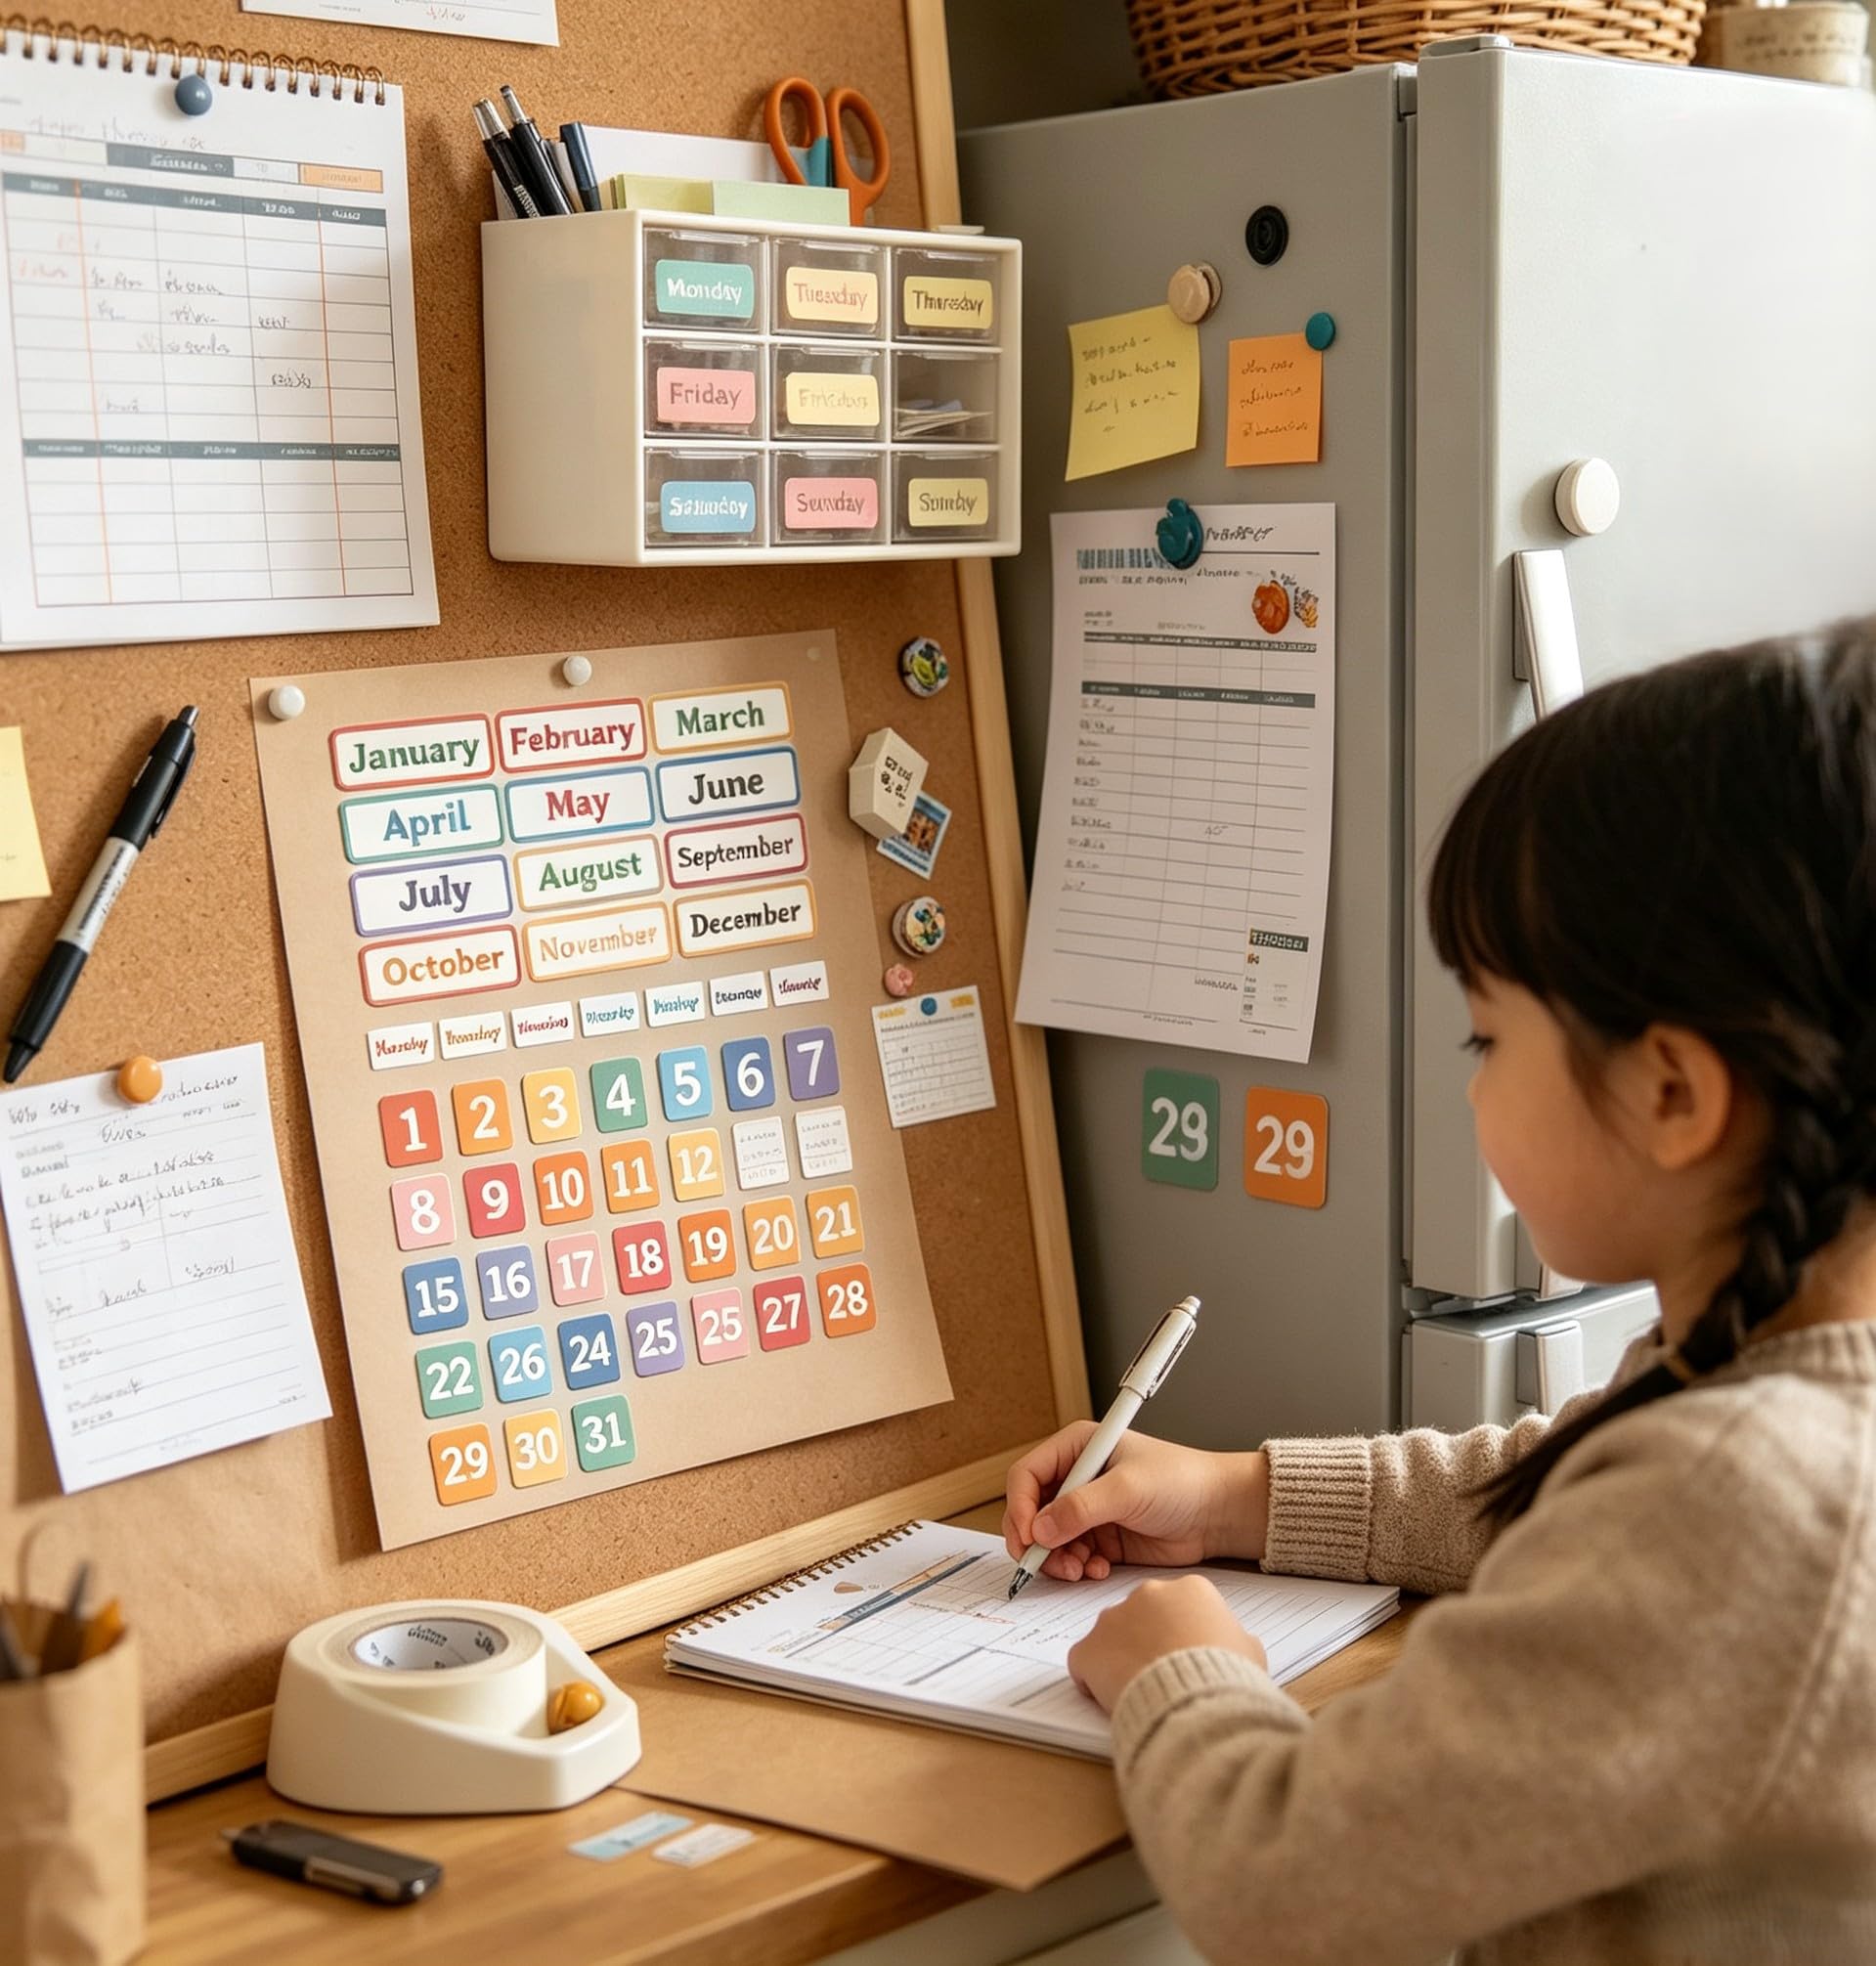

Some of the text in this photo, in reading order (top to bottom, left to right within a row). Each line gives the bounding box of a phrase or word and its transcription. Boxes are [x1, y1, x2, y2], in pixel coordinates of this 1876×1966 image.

[667, 278, 742, 305] Monday
[670, 382, 742, 409] Friday
[676, 701, 765, 735] March
[349, 737, 479, 773] January
[510, 721, 634, 755] February
[545, 789, 611, 823] May
[688, 770, 764, 805] June
[383, 799, 471, 847] April
[539, 852, 642, 892] August
[678, 837, 794, 871] September
[399, 874, 471, 913] July
[690, 903, 802, 938] December
[540, 925, 657, 962] November
[382, 948, 504, 986] October
[399, 1040, 825, 1152] 1 2 3 4 5 6 7
[1149, 1097, 1208, 1162] 29
[1254, 1114, 1315, 1179] 29
[410, 1190, 441, 1234] 8
[481, 1180, 508, 1219] 9
[544, 1168, 585, 1210] 10
[611, 1157, 652, 1198] 11
[676, 1145, 718, 1185] 12
[416, 1201, 856, 1318] 15 16 17 18 19 20 21
[426, 1280, 868, 1400] 22 26 24 25 25 27 28
[440, 1412, 627, 1486] 29 30 31
